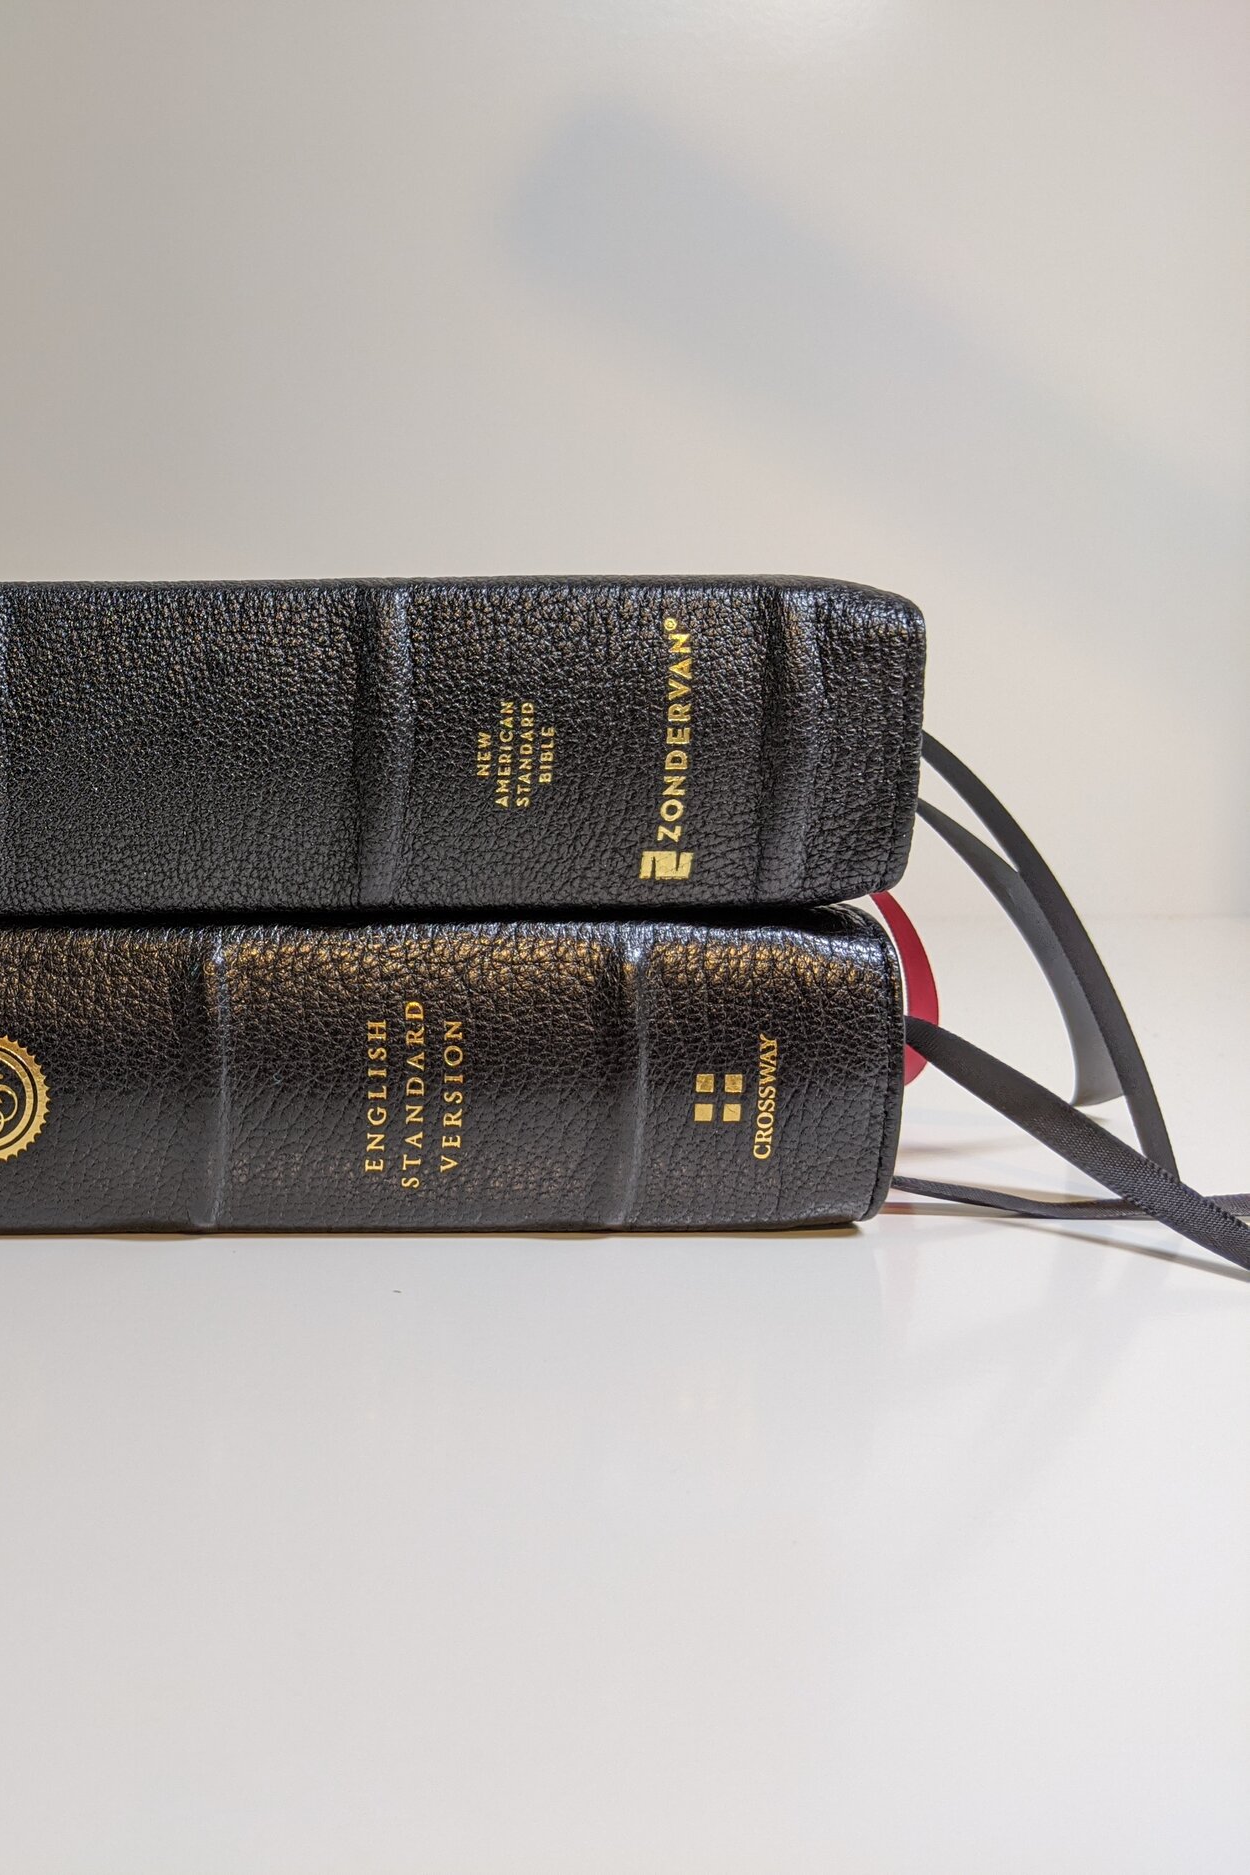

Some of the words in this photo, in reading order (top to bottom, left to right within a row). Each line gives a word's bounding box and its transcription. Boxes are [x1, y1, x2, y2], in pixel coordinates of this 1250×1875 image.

[477, 731, 491, 777] NEW
[495, 700, 514, 808] AMERICAN
[515, 701, 534, 807] STANDARD
[538, 727, 555, 784] BIBLE
[365, 1020, 388, 1174] ENGLISH
[402, 1000, 426, 1190] STANDARD
[440, 1020, 464, 1174] VERSION
[753, 1034, 778, 1160] CROSSWAY
